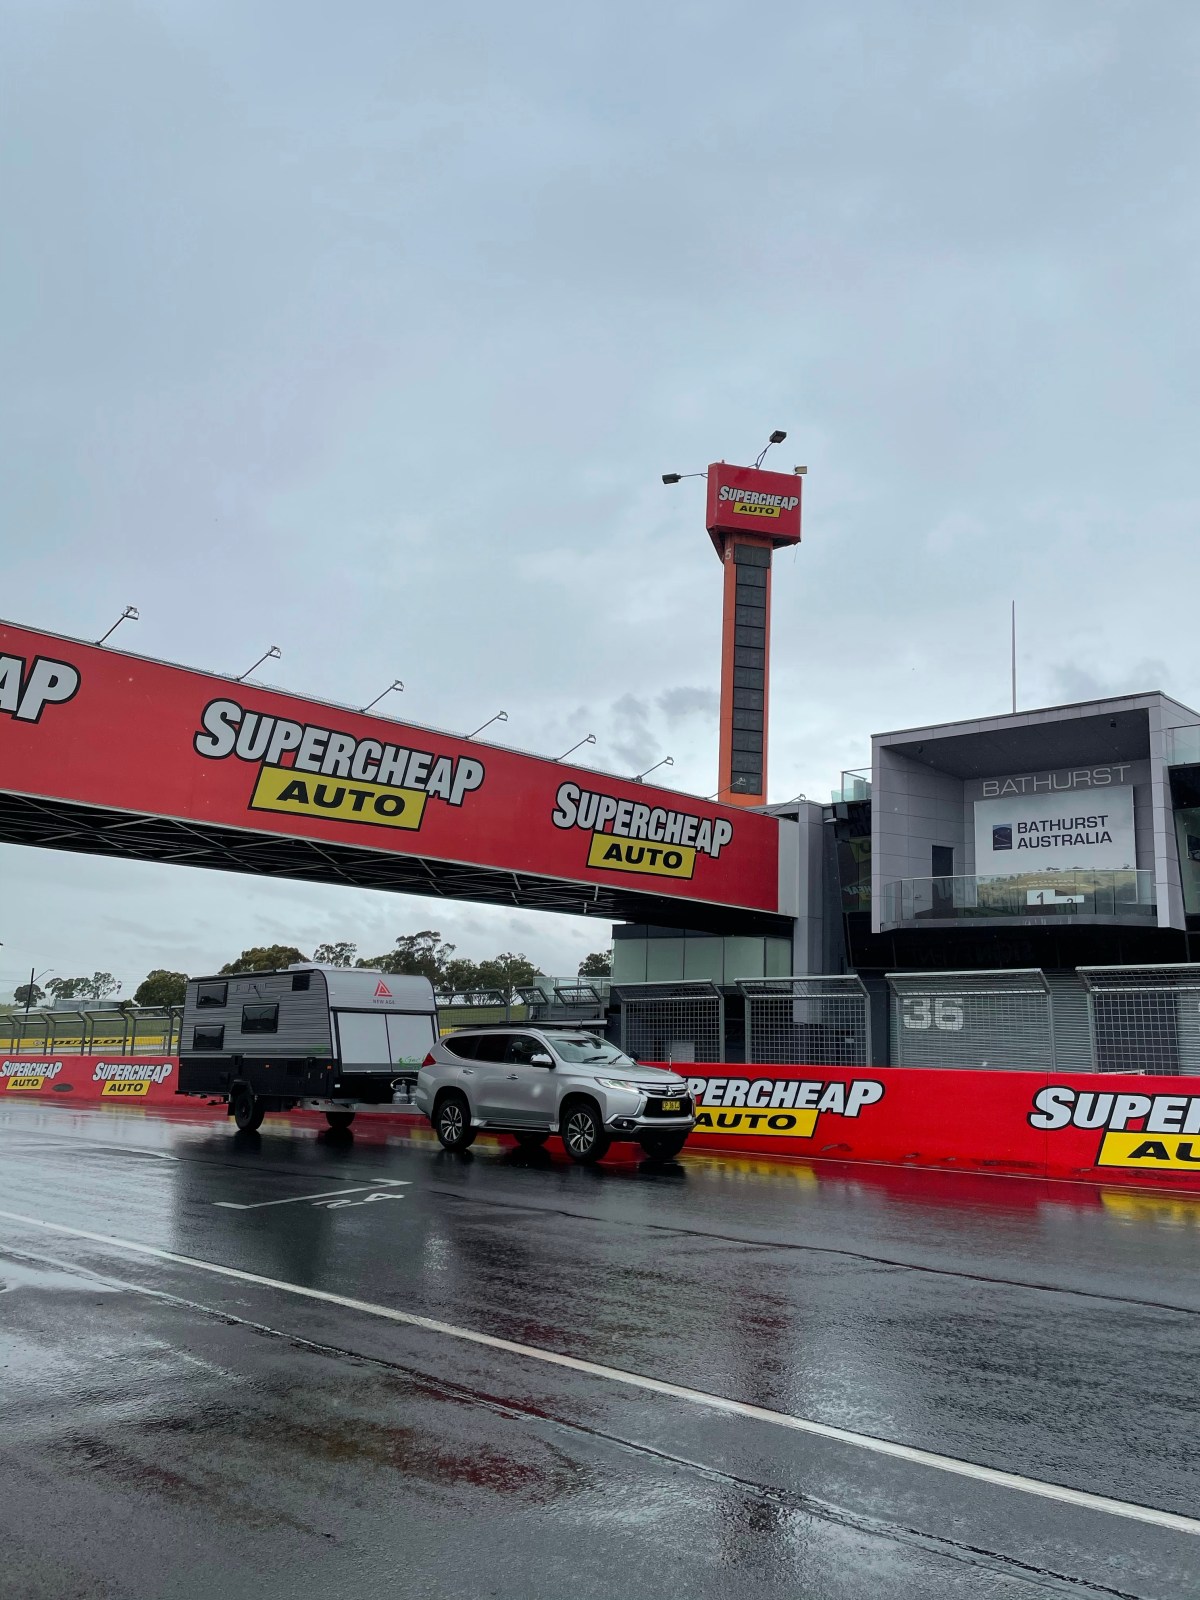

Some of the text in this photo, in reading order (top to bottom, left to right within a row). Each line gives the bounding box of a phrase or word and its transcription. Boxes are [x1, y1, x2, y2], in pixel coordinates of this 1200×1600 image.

[718, 485, 799, 511] SUPERCHEAP
[739, 505, 775, 515] AUTO
[194, 698, 485, 807] SUPERCHEAP
[982, 765, 1131, 797] BATHURST
[276, 780, 406, 817] AUTO
[552, 781, 733, 859] SUPERCHEAP
[1017, 815, 1109, 834] BATHURST
[1017, 831, 1112, 849] AUSTRALIA
[602, 843, 683, 869] AUTO
[903, 998, 964, 1030] 36
[0, 1061, 63, 1079] SUPERCHEAP
[93, 1063, 173, 1084] SUPERCHEAP
[12, 1079, 39, 1087] AUTO
[108, 1084, 144, 1092] AUTO
[695, 1113, 797, 1130] AUTO
